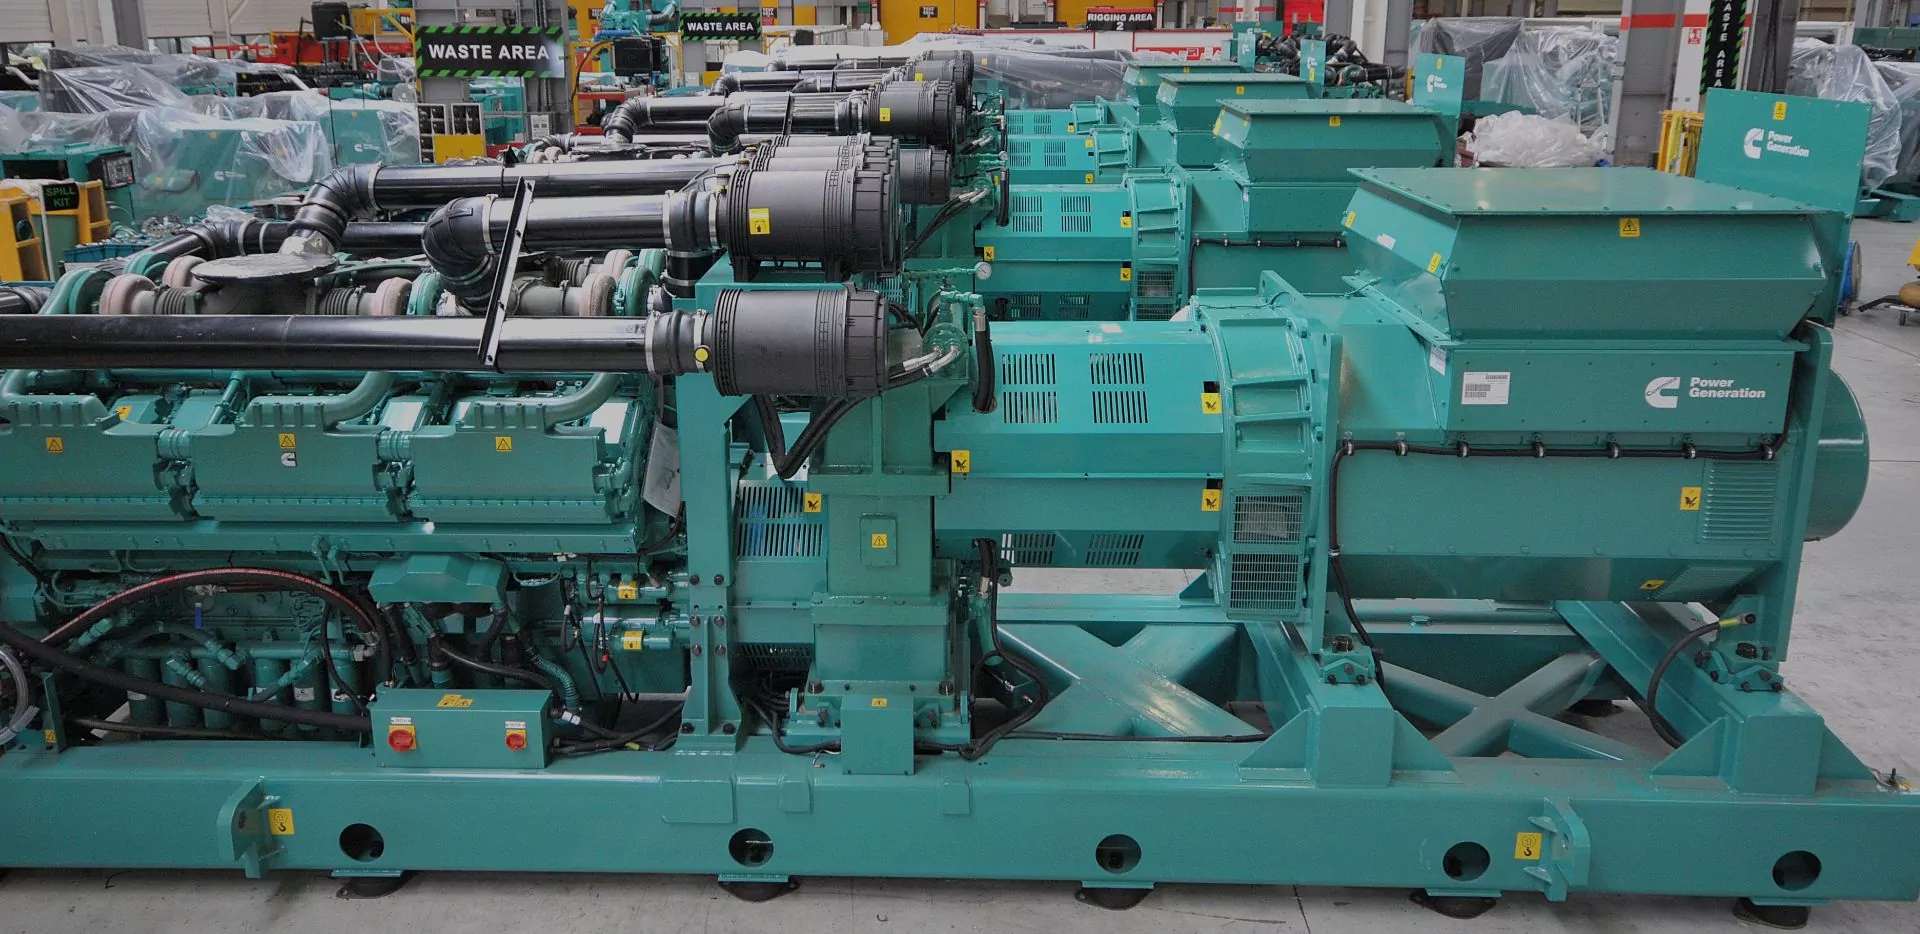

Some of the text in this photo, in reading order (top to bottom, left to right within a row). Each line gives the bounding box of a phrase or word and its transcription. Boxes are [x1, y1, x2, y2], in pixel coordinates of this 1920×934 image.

[1088, 13, 1153, 21] RIGGING AREA
[687, 22, 754, 31] WASTE AREA
[1116, 21, 1124, 30] 2
[1714, 0, 1732, 87] ASTE AREA
[428, 44, 549, 59] WASTE AREA
[1767, 130, 1793, 144] Power
[1766, 140, 1810, 157] Generation
[46, 186, 76, 196] SPILL
[53, 197, 70, 207] KIT
[1690, 377, 1734, 388] Power
[1689, 387, 1766, 398] Generation
